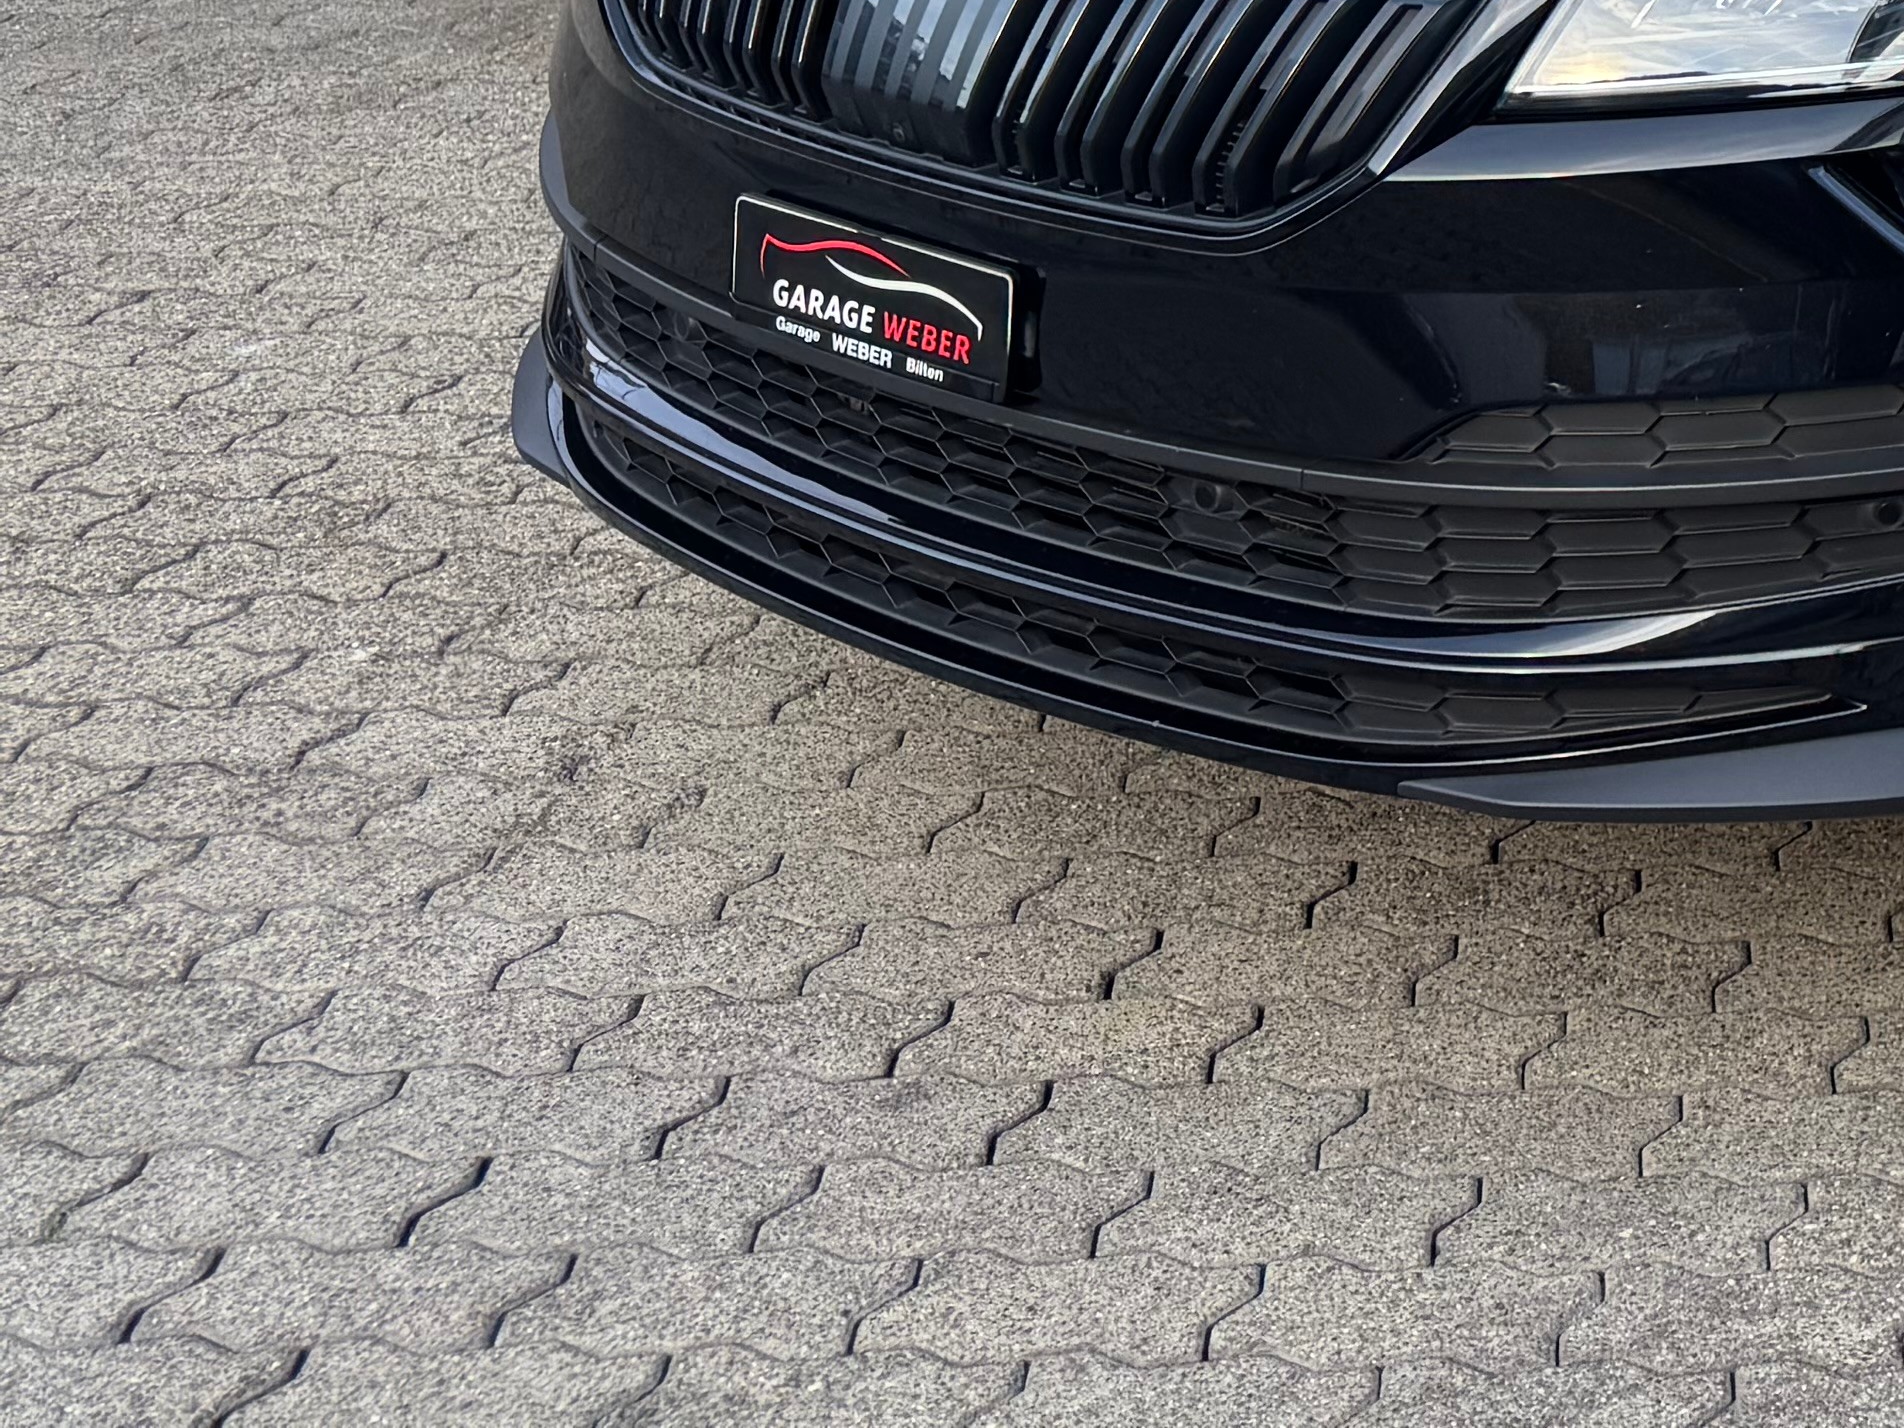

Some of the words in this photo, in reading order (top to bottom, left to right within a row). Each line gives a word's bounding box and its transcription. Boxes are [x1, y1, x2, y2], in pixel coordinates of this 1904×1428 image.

[773, 278, 876, 334] GARAGE
[883, 311, 971, 364] WEBER
[776, 316, 821, 343] Garage
[832, 333, 893, 369] WEBER
